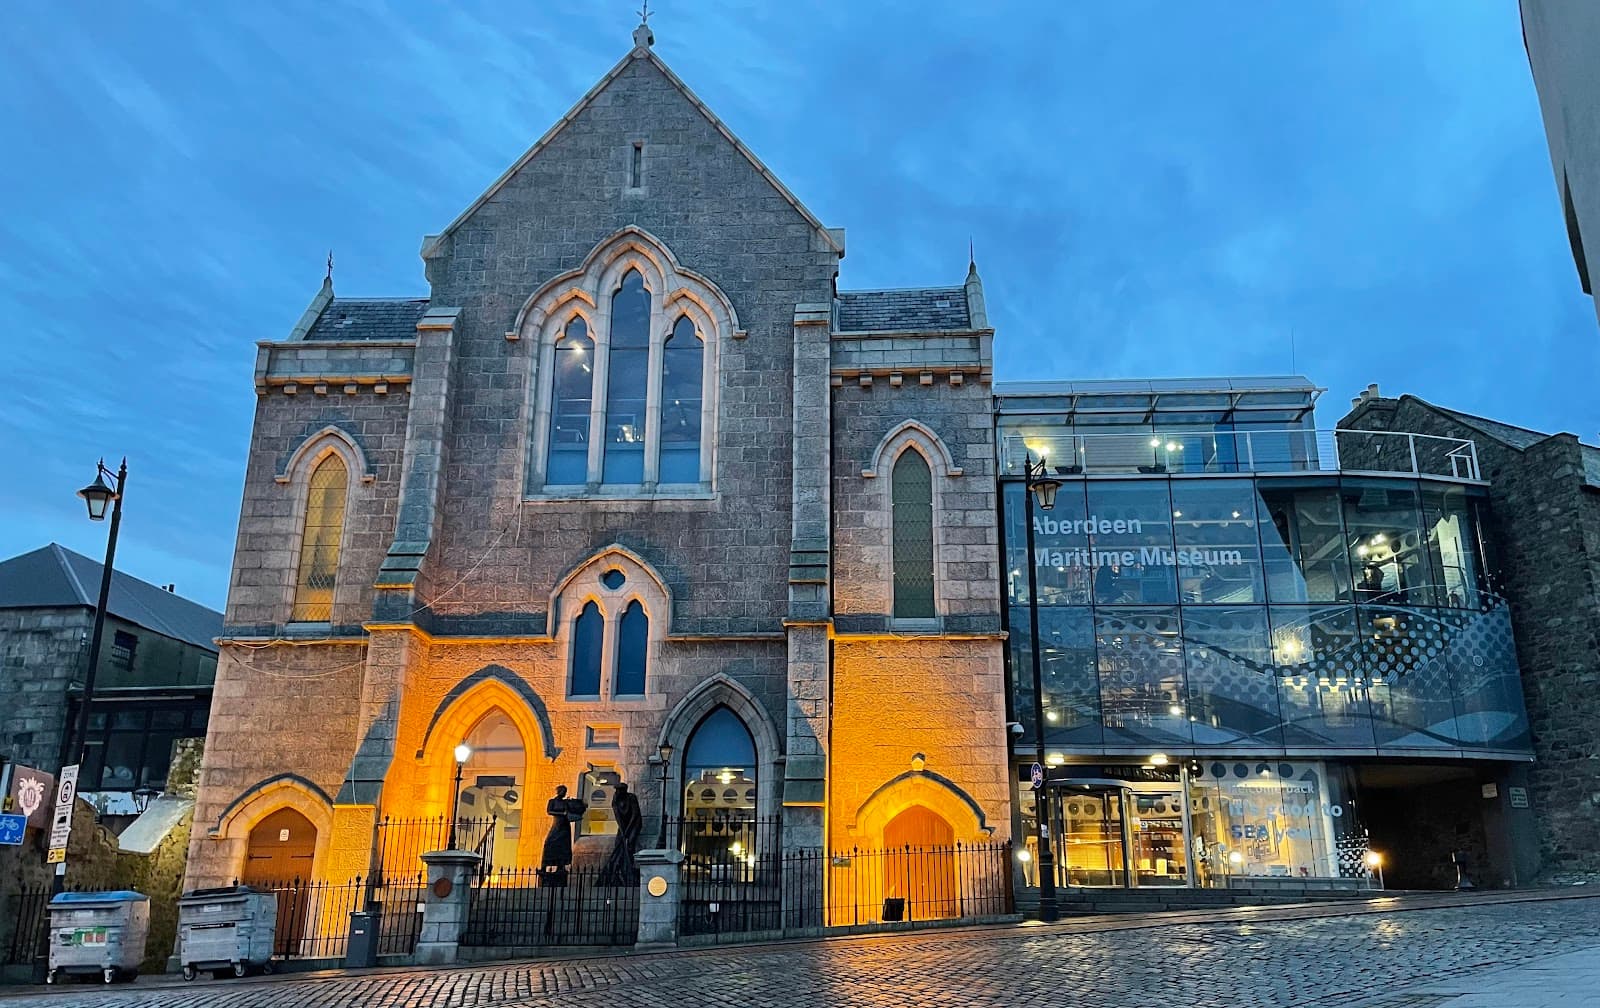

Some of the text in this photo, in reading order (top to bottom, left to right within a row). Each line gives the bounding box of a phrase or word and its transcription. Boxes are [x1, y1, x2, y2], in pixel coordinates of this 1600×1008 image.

[1033, 515, 1142, 535] Aberdeen
[1035, 547, 1242, 567] Maritime Museum
[1286, 784, 1315, 794] back
[1266, 800, 1315, 821] good
[1322, 802, 1343, 817] to
[1231, 825, 1268, 838] SEA
